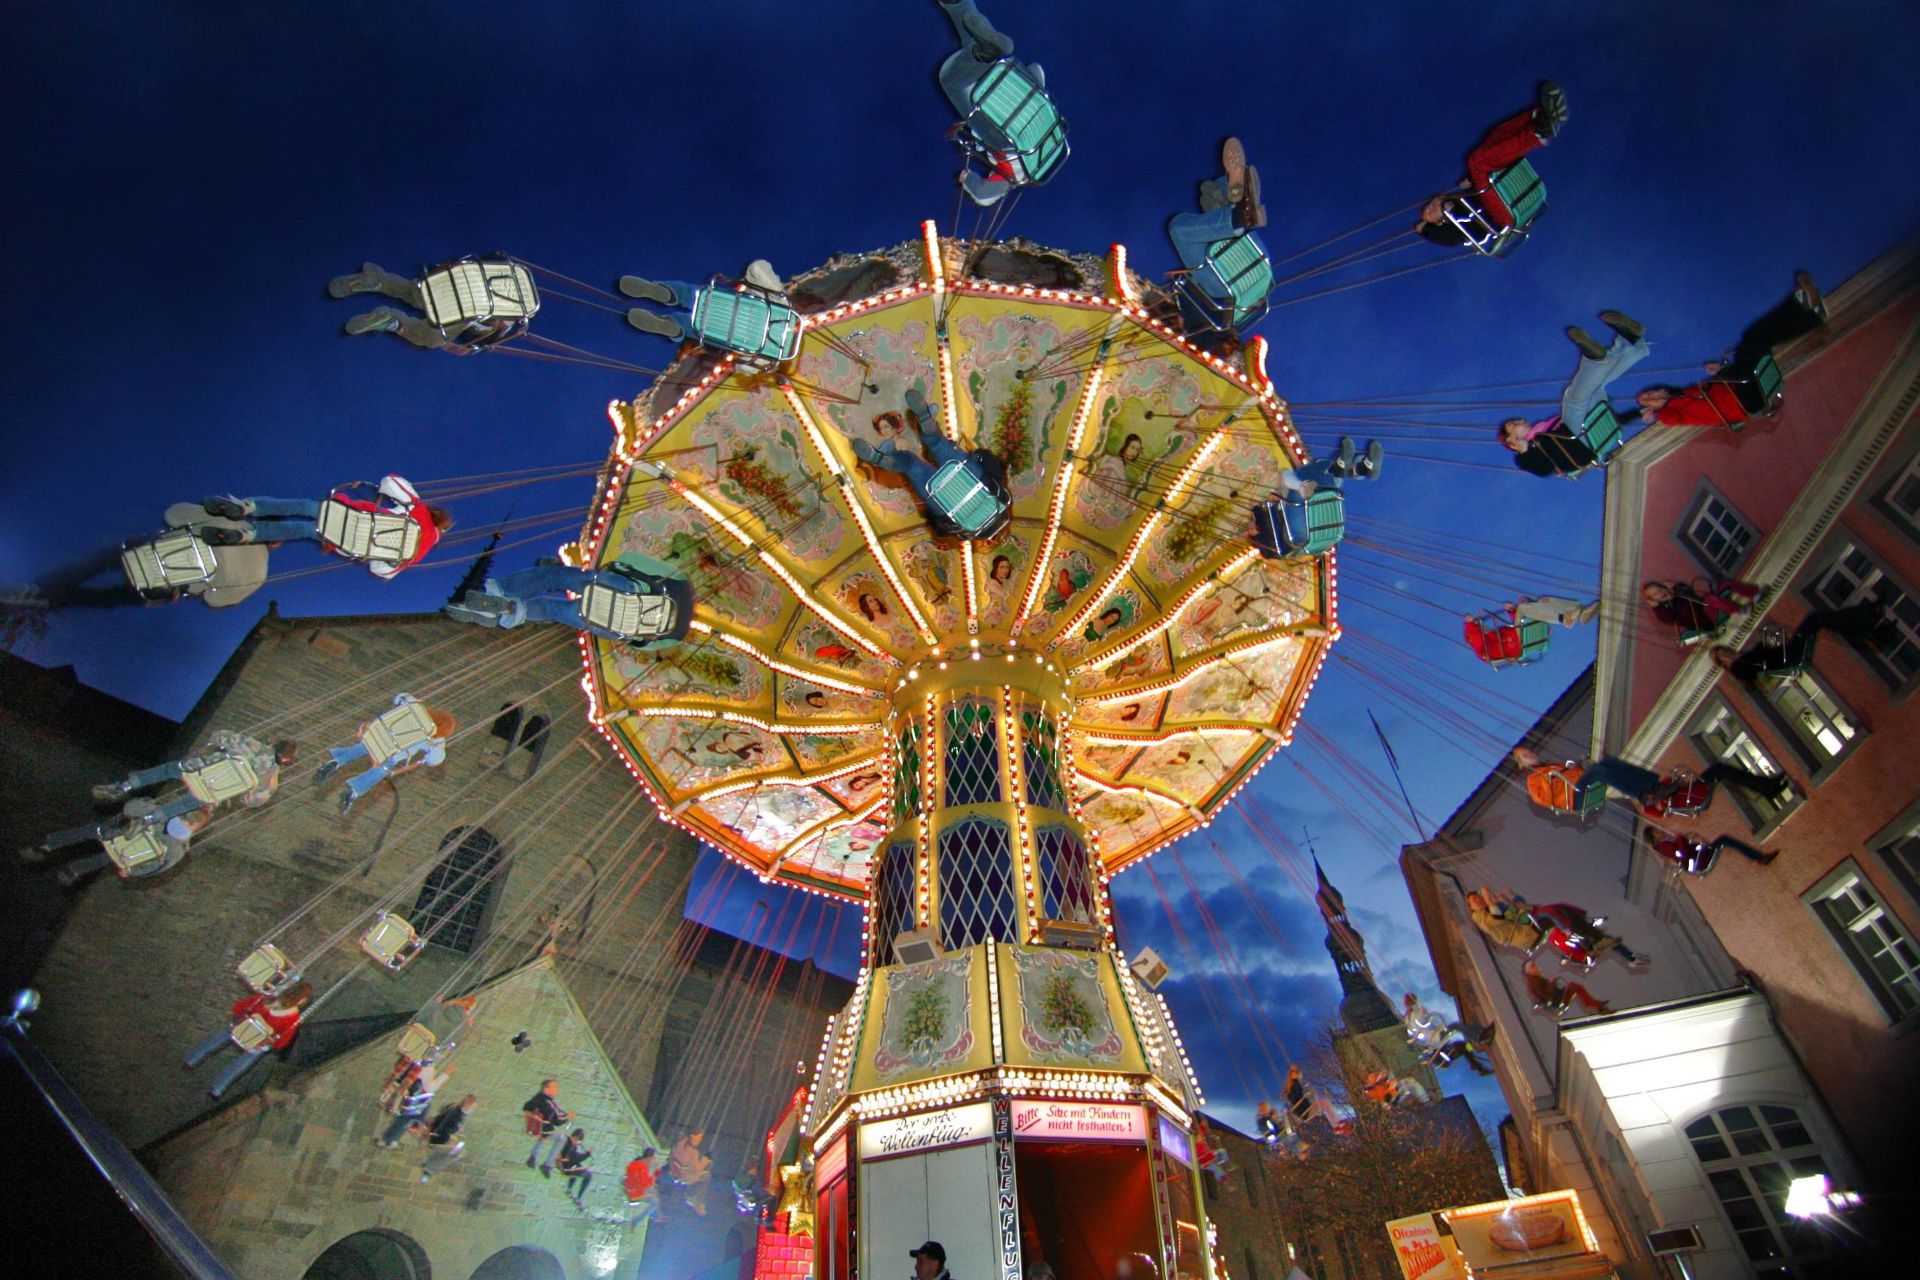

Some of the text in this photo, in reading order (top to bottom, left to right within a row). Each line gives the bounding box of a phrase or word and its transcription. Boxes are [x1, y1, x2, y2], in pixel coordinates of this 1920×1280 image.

[1015, 1107, 1039, 1131] Bitte
[1046, 1105, 1131, 1120] Sitze mit Kindern
[895, 1117, 920, 1132] Der
[1048, 1119, 1073, 1131] nicht
